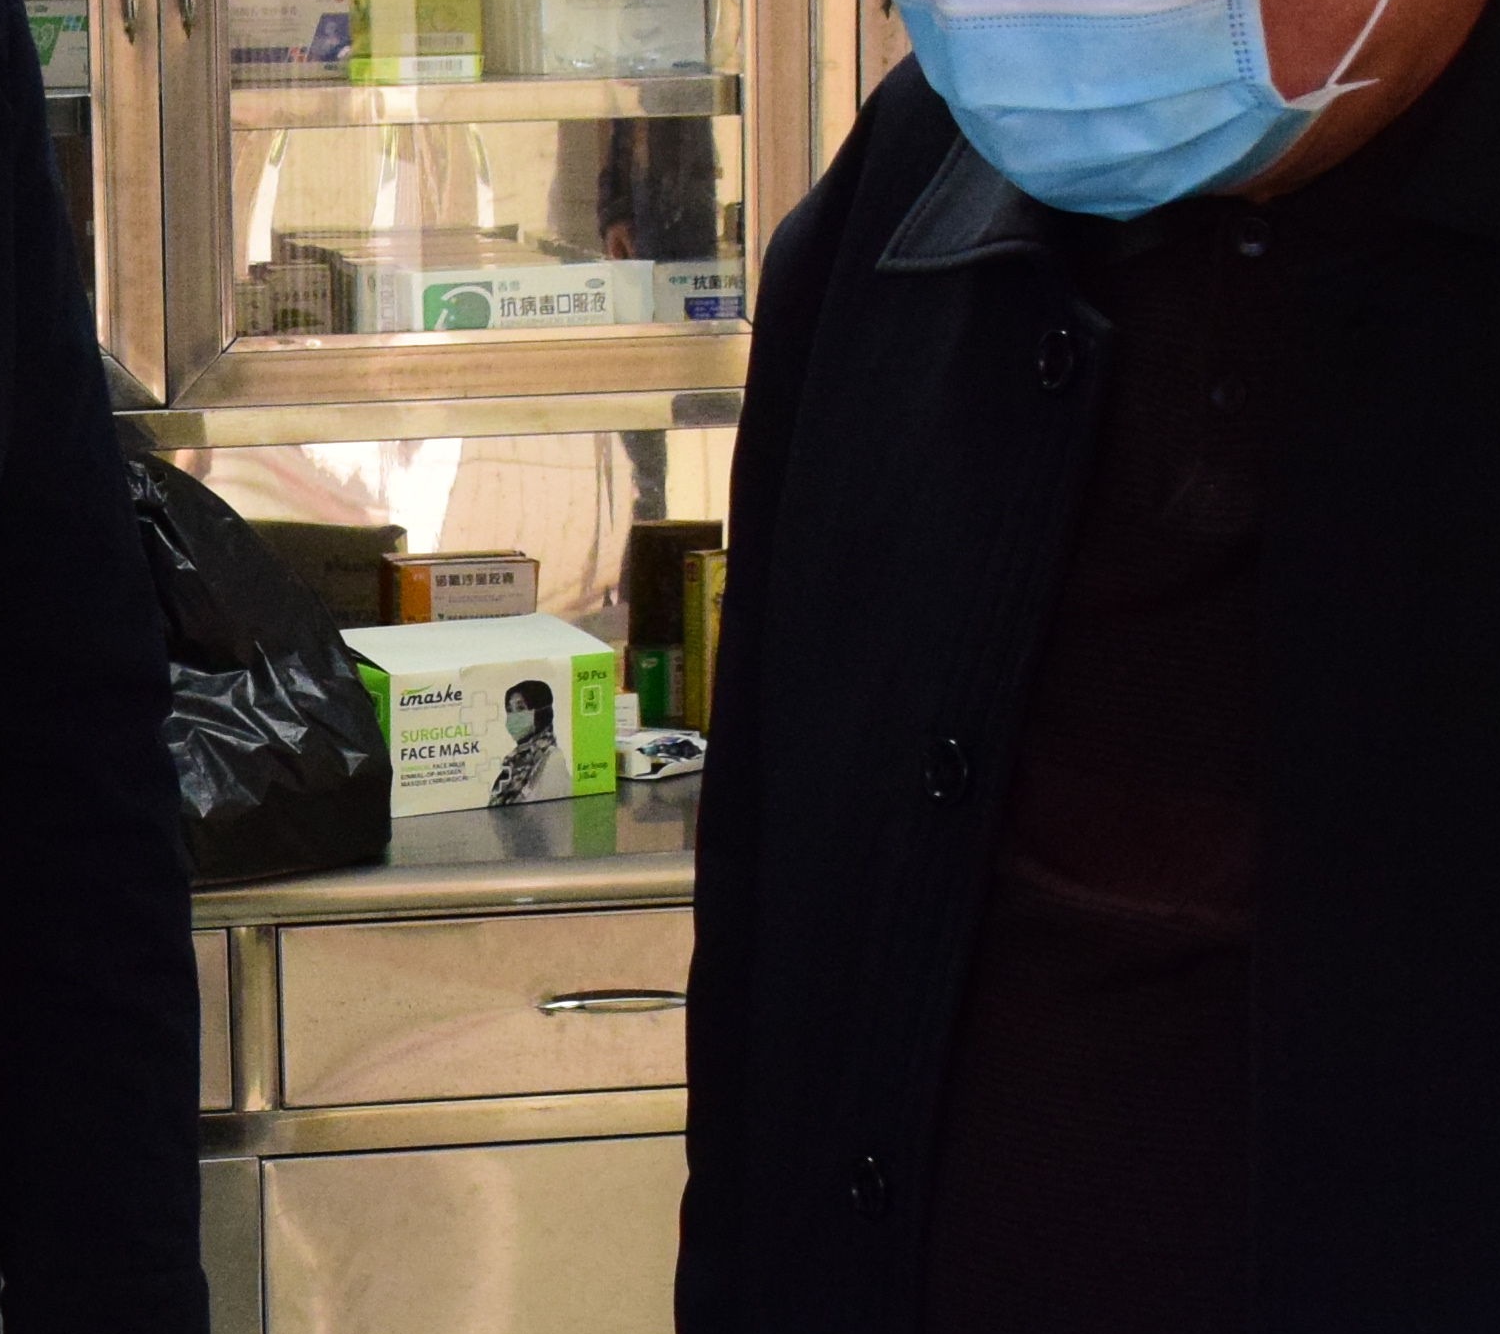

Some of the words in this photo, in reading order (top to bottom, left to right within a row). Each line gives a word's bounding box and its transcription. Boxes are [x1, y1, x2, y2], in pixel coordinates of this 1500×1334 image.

[500, 292, 607, 318] 抗病毒口服液
[577, 671, 590, 681] 50
[401, 724, 472, 744] SURGICAL
[401, 744, 437, 761] FACE
[439, 740, 481, 758] MASK
